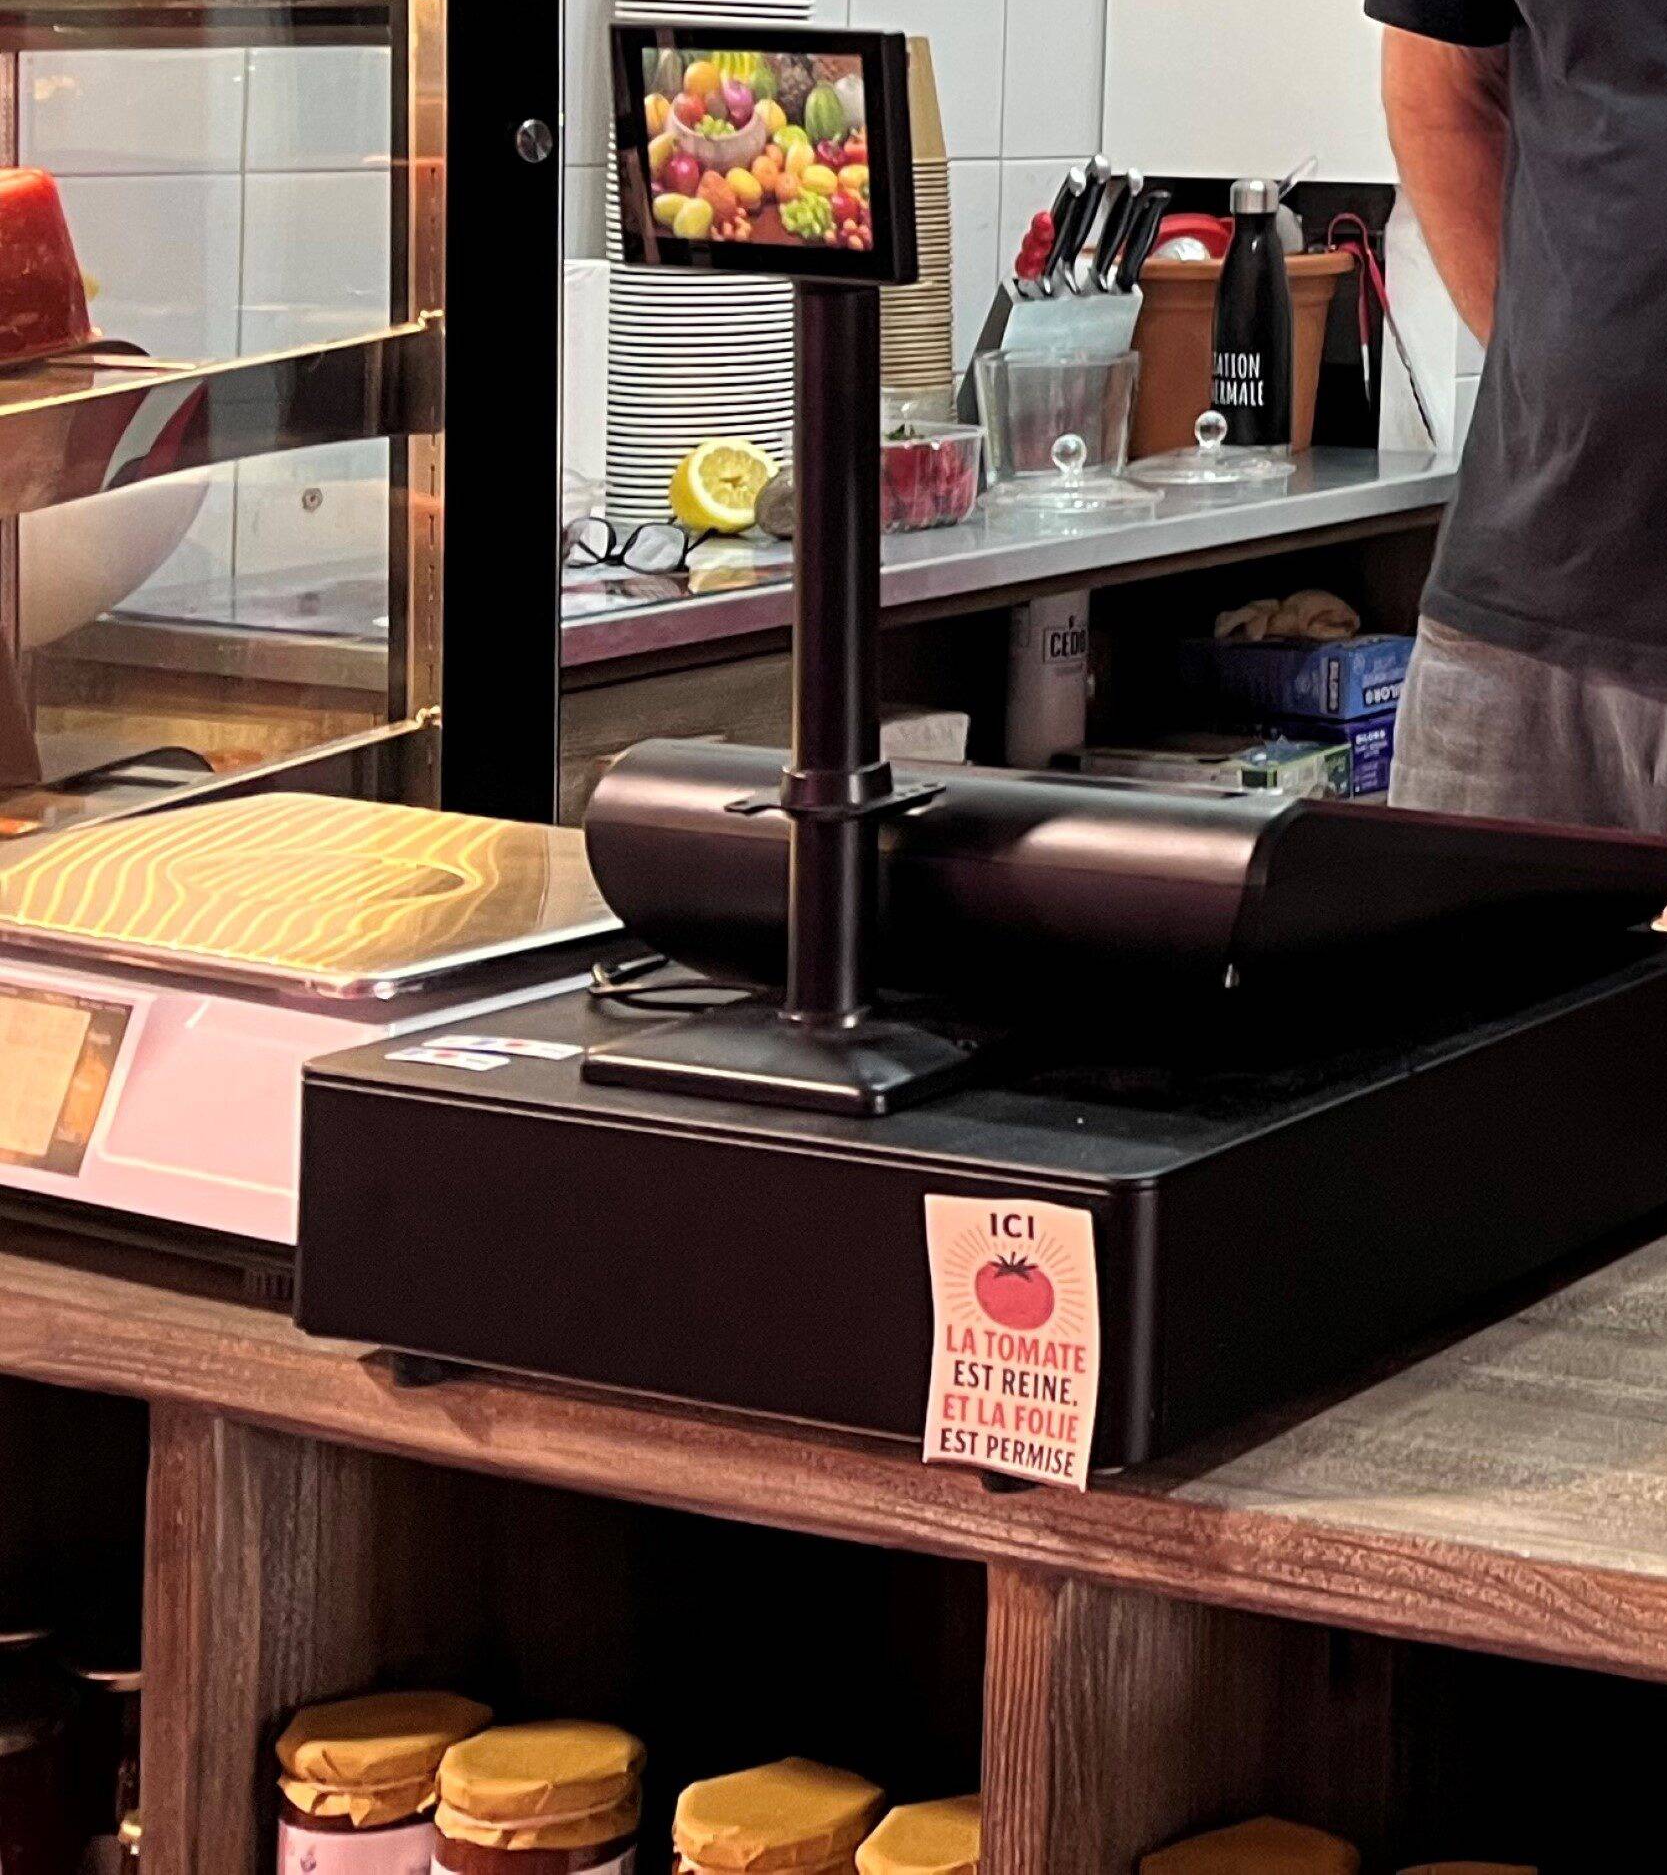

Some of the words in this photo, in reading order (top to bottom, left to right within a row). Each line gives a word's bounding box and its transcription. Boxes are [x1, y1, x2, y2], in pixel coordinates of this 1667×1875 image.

[990, 1213, 1035, 1239] ICI
[946, 1324, 974, 1356] LA
[984, 1330, 1086, 1374] TOMATE
[954, 1360, 993, 1390] EST
[942, 1394, 968, 1422] ET
[978, 1399, 1006, 1429] LA
[1015, 1404, 1079, 1444] FOLIE
[940, 1428, 979, 1455] EST
[987, 1435, 1076, 1477] PERMISE
